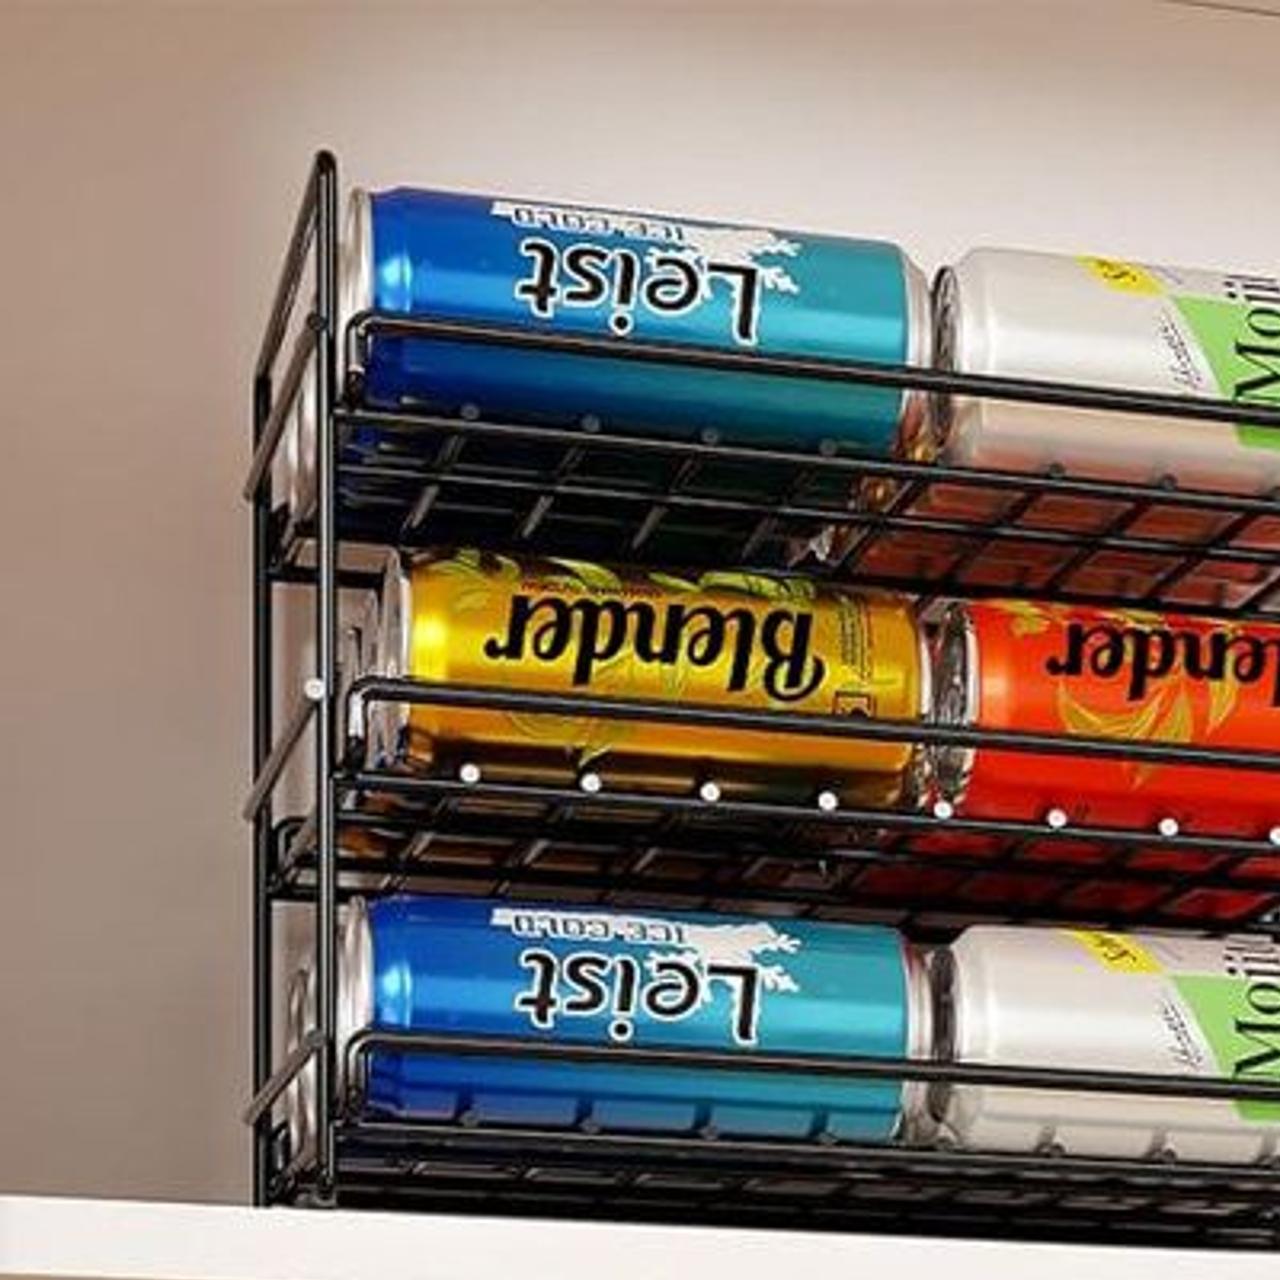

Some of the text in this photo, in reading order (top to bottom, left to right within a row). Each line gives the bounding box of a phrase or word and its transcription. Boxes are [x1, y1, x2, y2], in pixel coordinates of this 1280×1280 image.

[518, 240, 760, 344] Leist
[485, 594, 827, 702] Blender
[517, 947, 760, 1048] Leist
